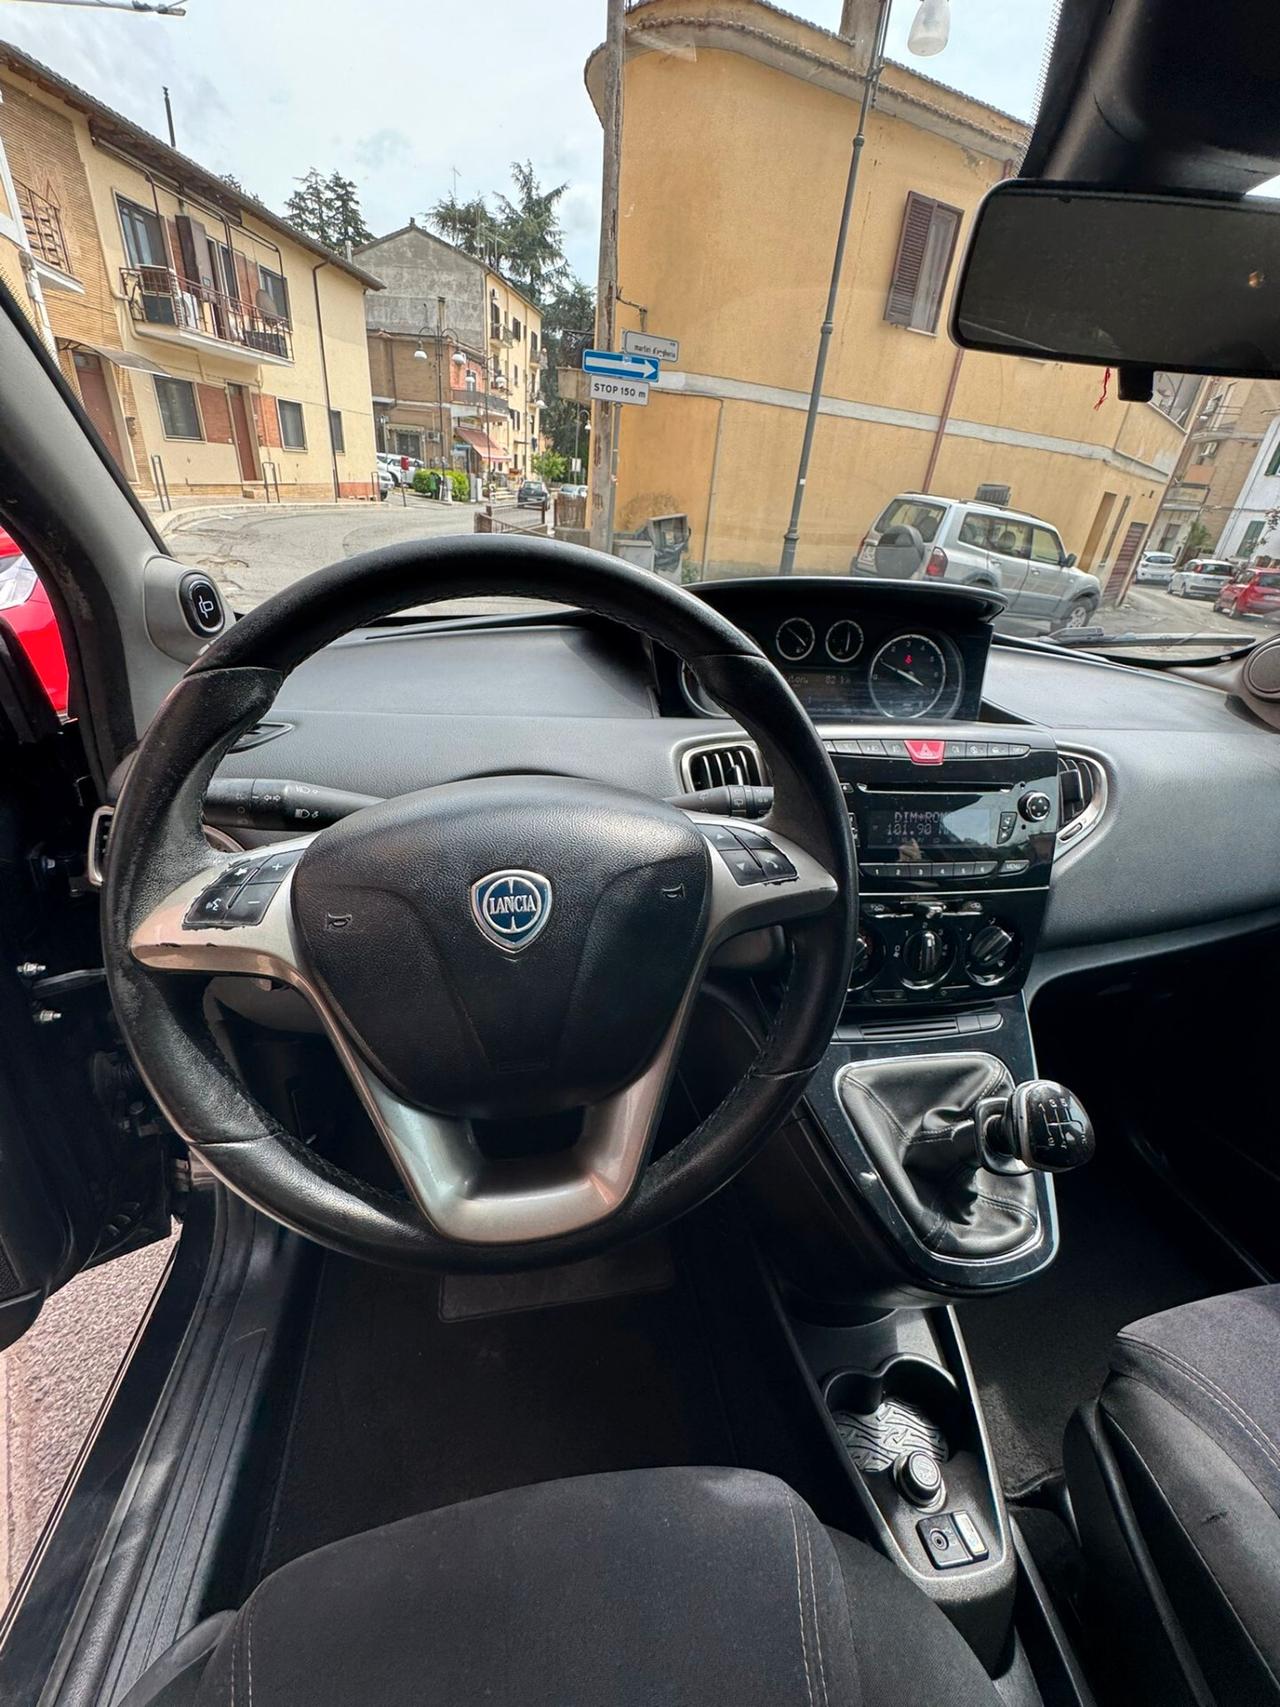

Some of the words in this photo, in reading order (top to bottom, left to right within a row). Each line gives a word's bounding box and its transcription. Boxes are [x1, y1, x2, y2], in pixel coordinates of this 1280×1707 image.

[593, 382, 618, 394] STOP
[620, 386, 636, 397] 150
[887, 823, 932, 836] 101.90
[489, 894, 537, 915] LANCIA
